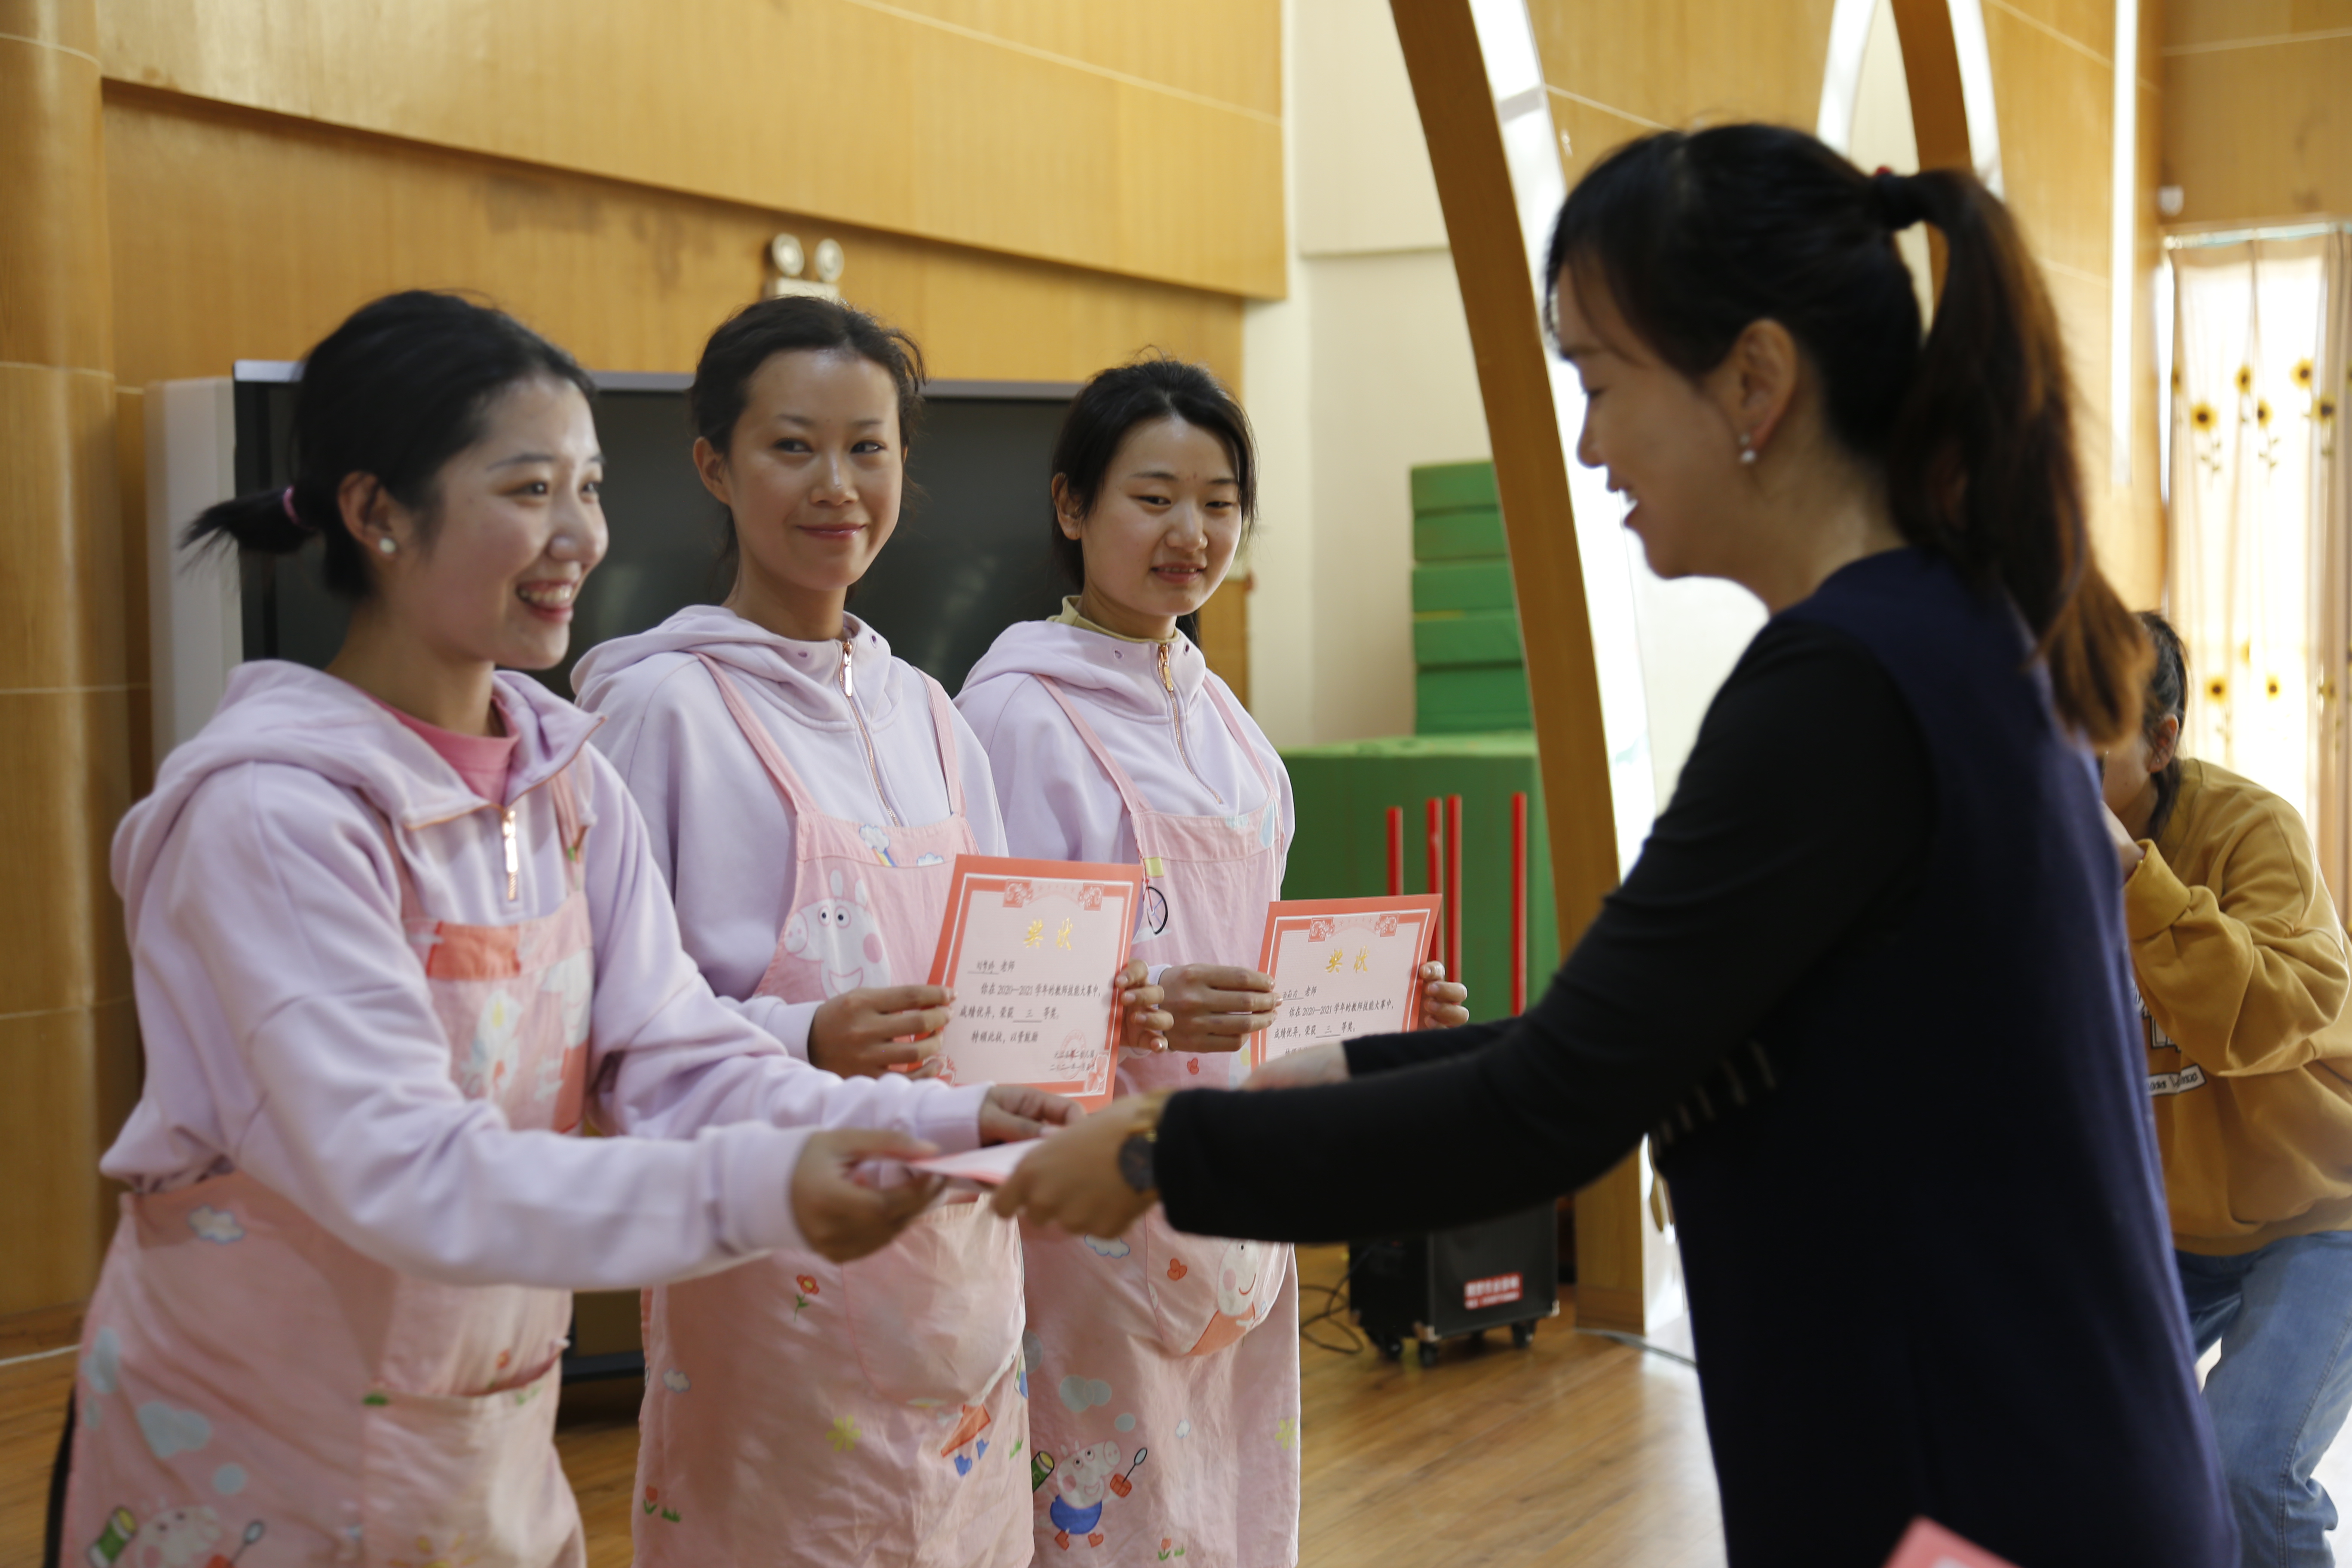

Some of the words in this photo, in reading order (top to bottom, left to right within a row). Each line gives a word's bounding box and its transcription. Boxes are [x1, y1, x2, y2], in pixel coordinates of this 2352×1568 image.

[1023, 917, 1073, 950] 奖状
[1000, 959, 1015, 972] 老师
[1326, 946, 1370, 974] 奖状
[1305, 985, 1317, 997] 老师
[1025, 1009, 1033, 1018] 三
[1324, 1025, 1332, 1034] 三
